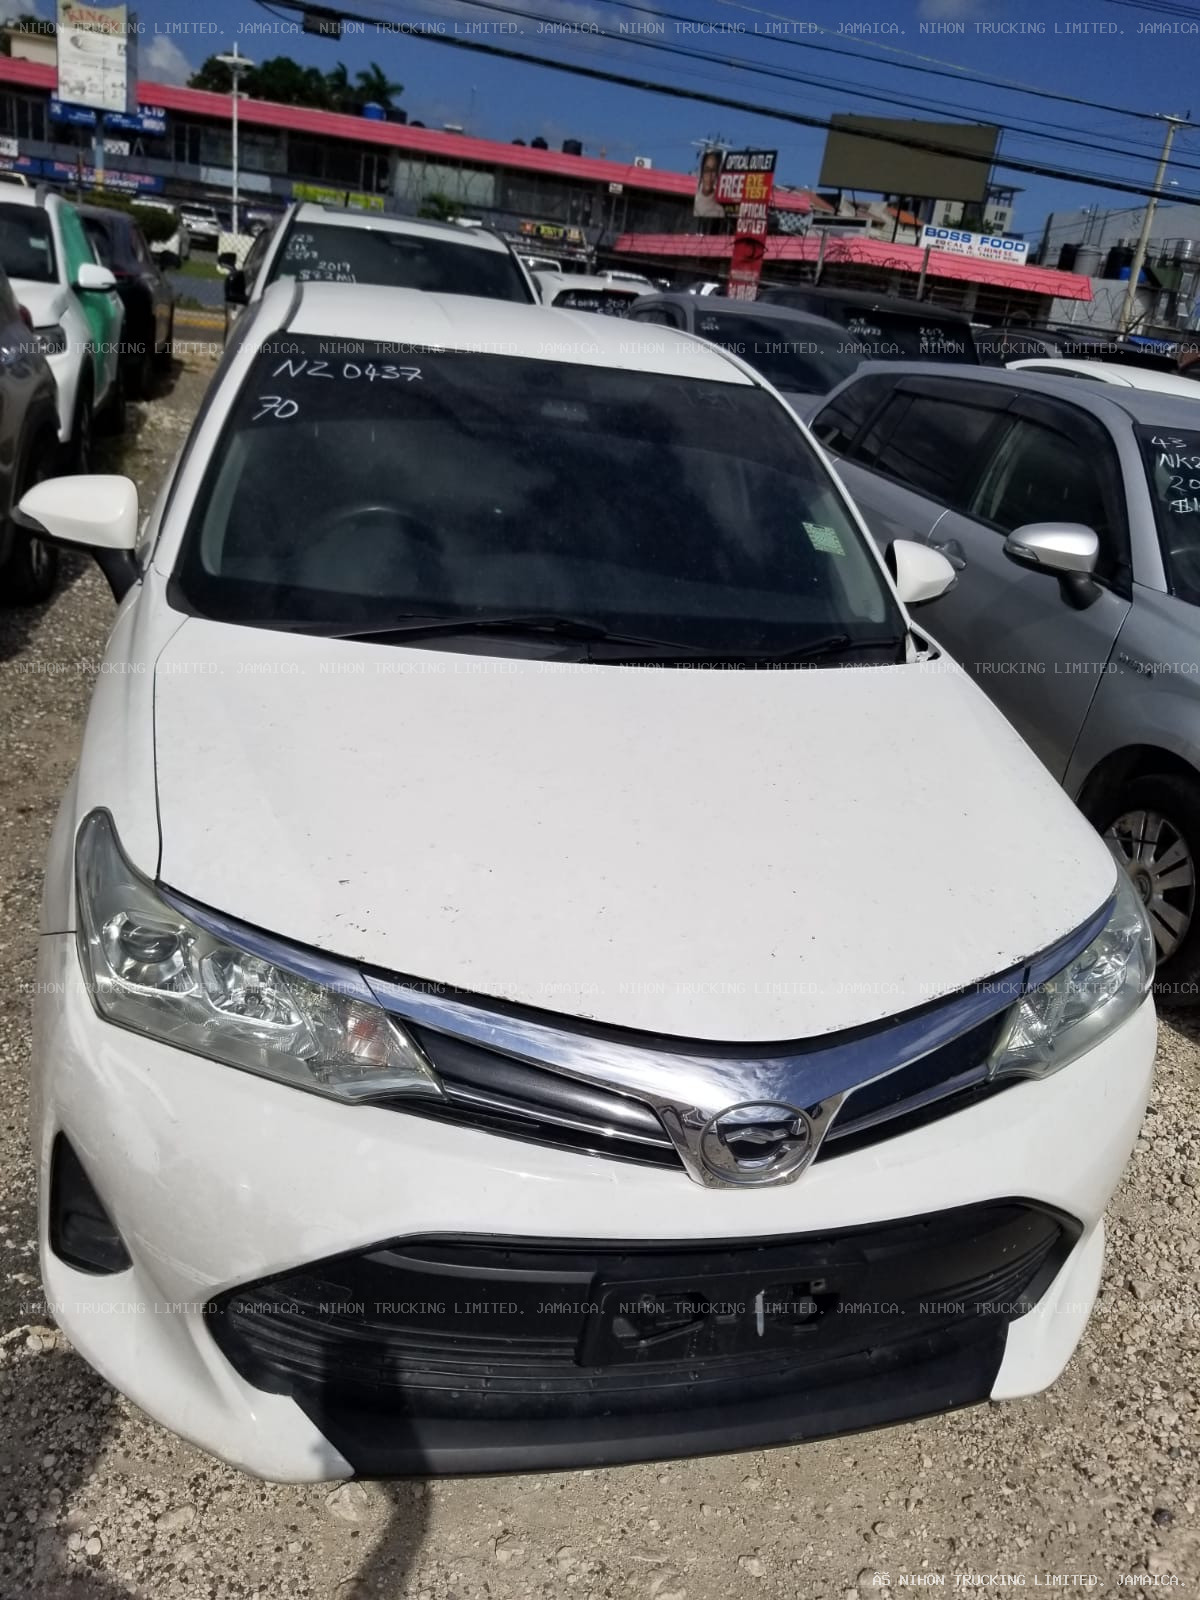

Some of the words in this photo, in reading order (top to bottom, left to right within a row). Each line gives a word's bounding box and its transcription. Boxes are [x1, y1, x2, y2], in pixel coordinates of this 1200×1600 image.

[726, 154, 750, 170] OPTICAL
[750, 154, 774, 170] OUTLET
[718, 173, 745, 199] FREE
[746, 174, 766, 187] EYE
[745, 186, 769, 199] TEST
[739, 202, 767, 219] OPTICAL
[737, 219, 767, 235] OUTLET
[925, 227, 973, 243] BOSS
[980, 236, 1026, 252] FOOD
[977, 246, 1013, 257] CHINESE
[342, 363, 423, 382] 0437
[252, 395, 299, 421] 70
[1151, 436, 1187, 449] 43
